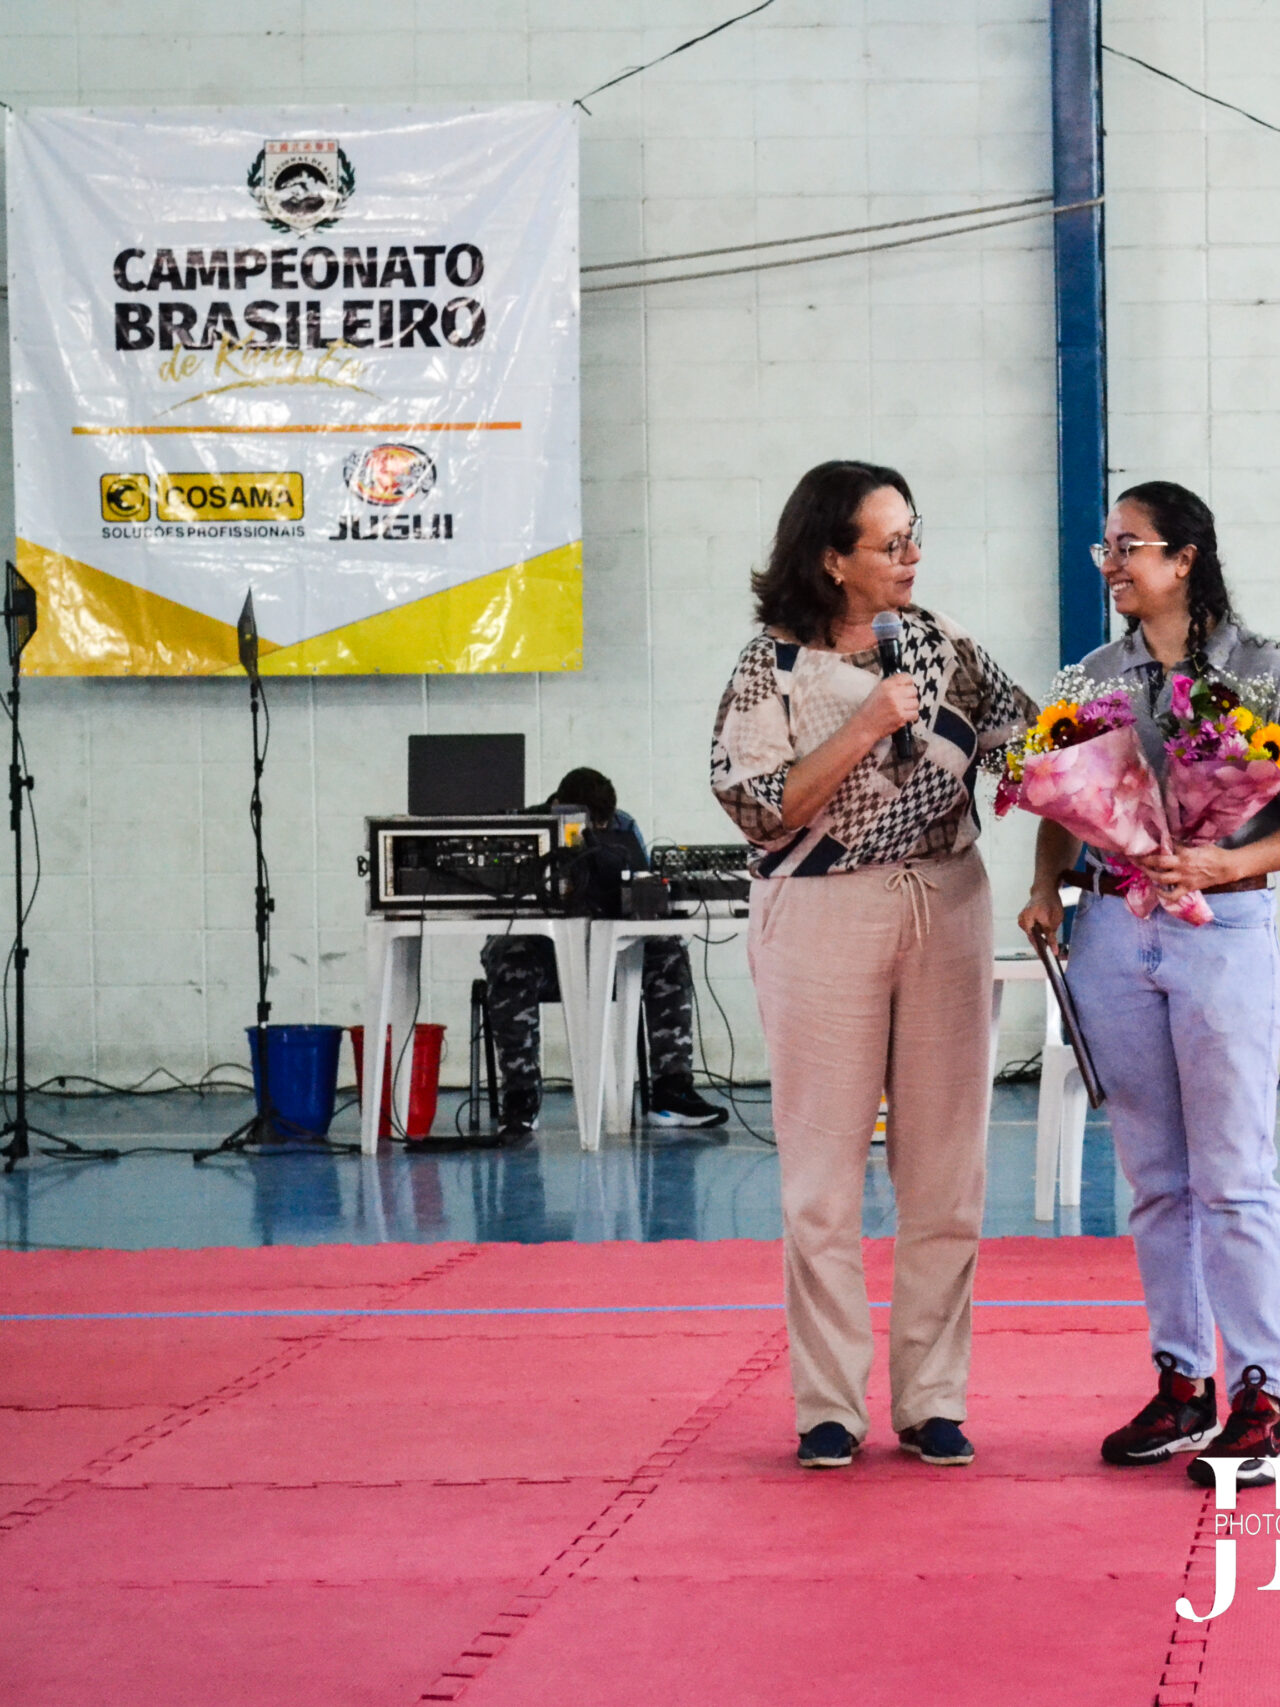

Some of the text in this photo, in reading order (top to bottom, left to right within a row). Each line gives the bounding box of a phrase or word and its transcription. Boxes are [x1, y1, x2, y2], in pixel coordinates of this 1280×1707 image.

[113, 243, 485, 292] CAMPEONATO
[114, 297, 487, 352] BRASILEIRO
[167, 486, 294, 509] COSAMA
[187, 524, 305, 539] PROFISSIONAIS
[328, 513, 453, 541] JUGUI
